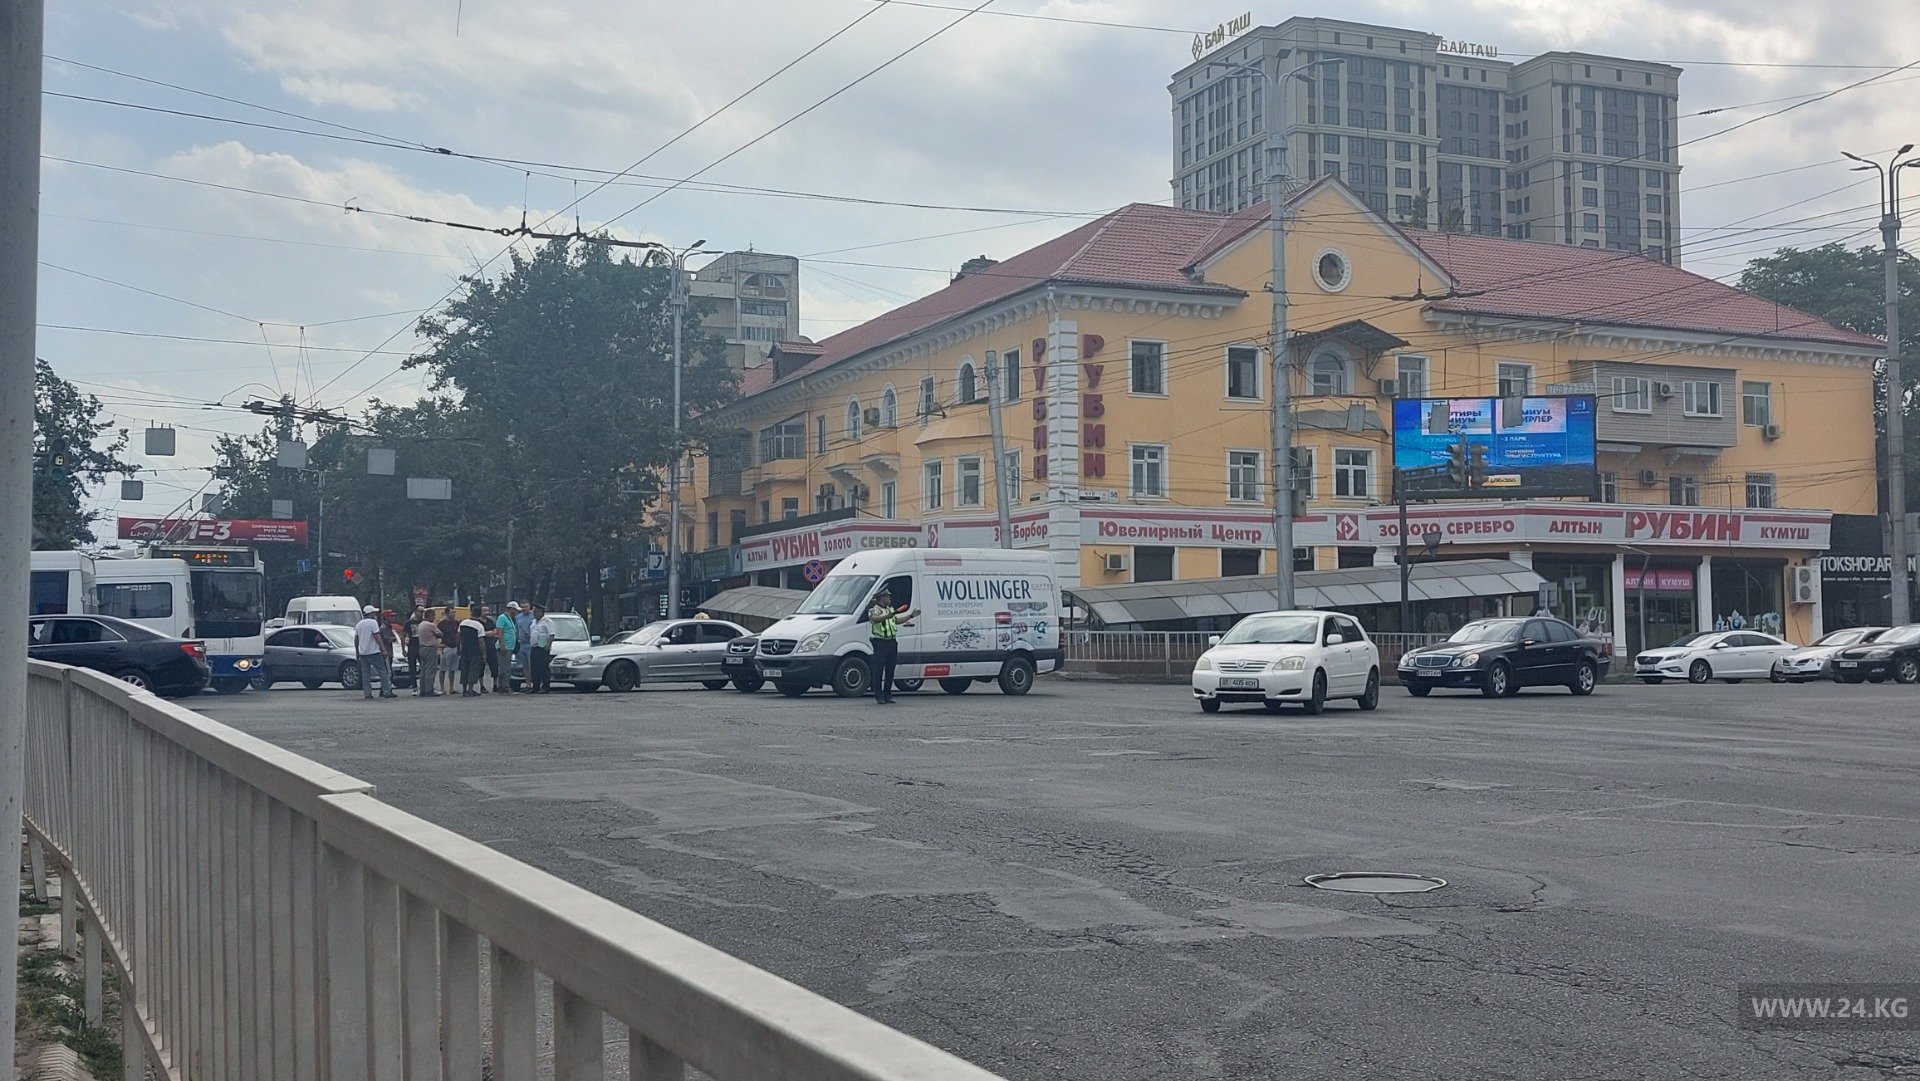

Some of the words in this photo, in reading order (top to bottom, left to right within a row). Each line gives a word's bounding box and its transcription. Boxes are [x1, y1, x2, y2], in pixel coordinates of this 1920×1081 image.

[1204, 23, 1226, 50] БАЙ
[1227, 11, 1251, 37] ТАШ
[1032, 338, 1048, 480] РУБИН
[1083, 334, 1106, 478] РУБИН
[187, 521, 232, 540] 1=3
[1013, 523, 1048, 541] Борбор
[1099, 520, 1203, 541] Ювелирный
[1211, 525, 1262, 543] Центр
[1446, 520, 1515, 535] СЕРЕБРО
[1549, 520, 1603, 534] АЛТЫН
[1625, 511, 1741, 541] РУБИН
[747, 550, 768, 563] АЛТЫН
[772, 531, 820, 561] РУБИН
[824, 537, 851, 552] ЗОЛОТО
[860, 535, 917, 548] СЕРЕБРО
[936, 579, 1032, 600] WOLLINGER
